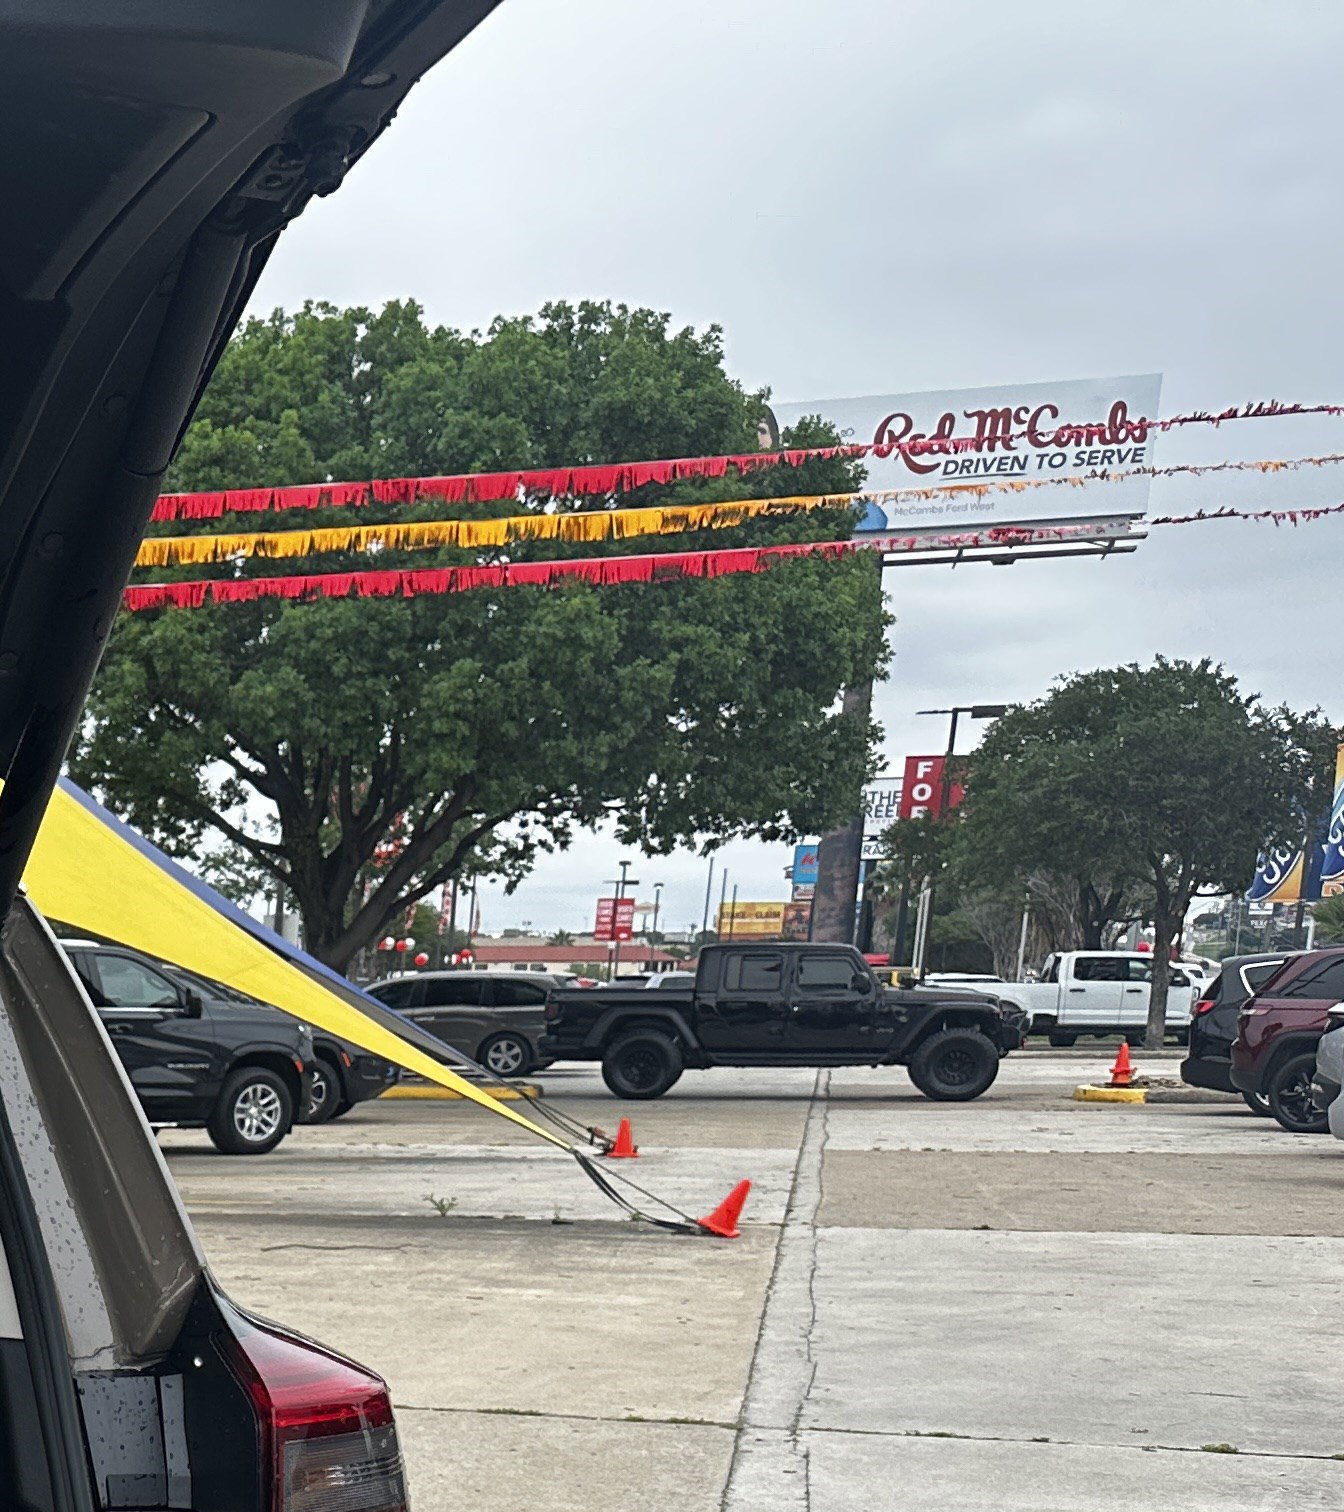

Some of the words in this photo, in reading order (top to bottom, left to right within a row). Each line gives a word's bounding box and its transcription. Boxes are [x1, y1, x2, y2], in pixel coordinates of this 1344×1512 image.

[873, 412, 956, 475] Red
[963, 400, 1148, 453] McCombs
[941, 454, 1030, 477] DRIVEN
[1034, 452, 1068, 470] TO
[1071, 446, 1147, 468] SERVE
